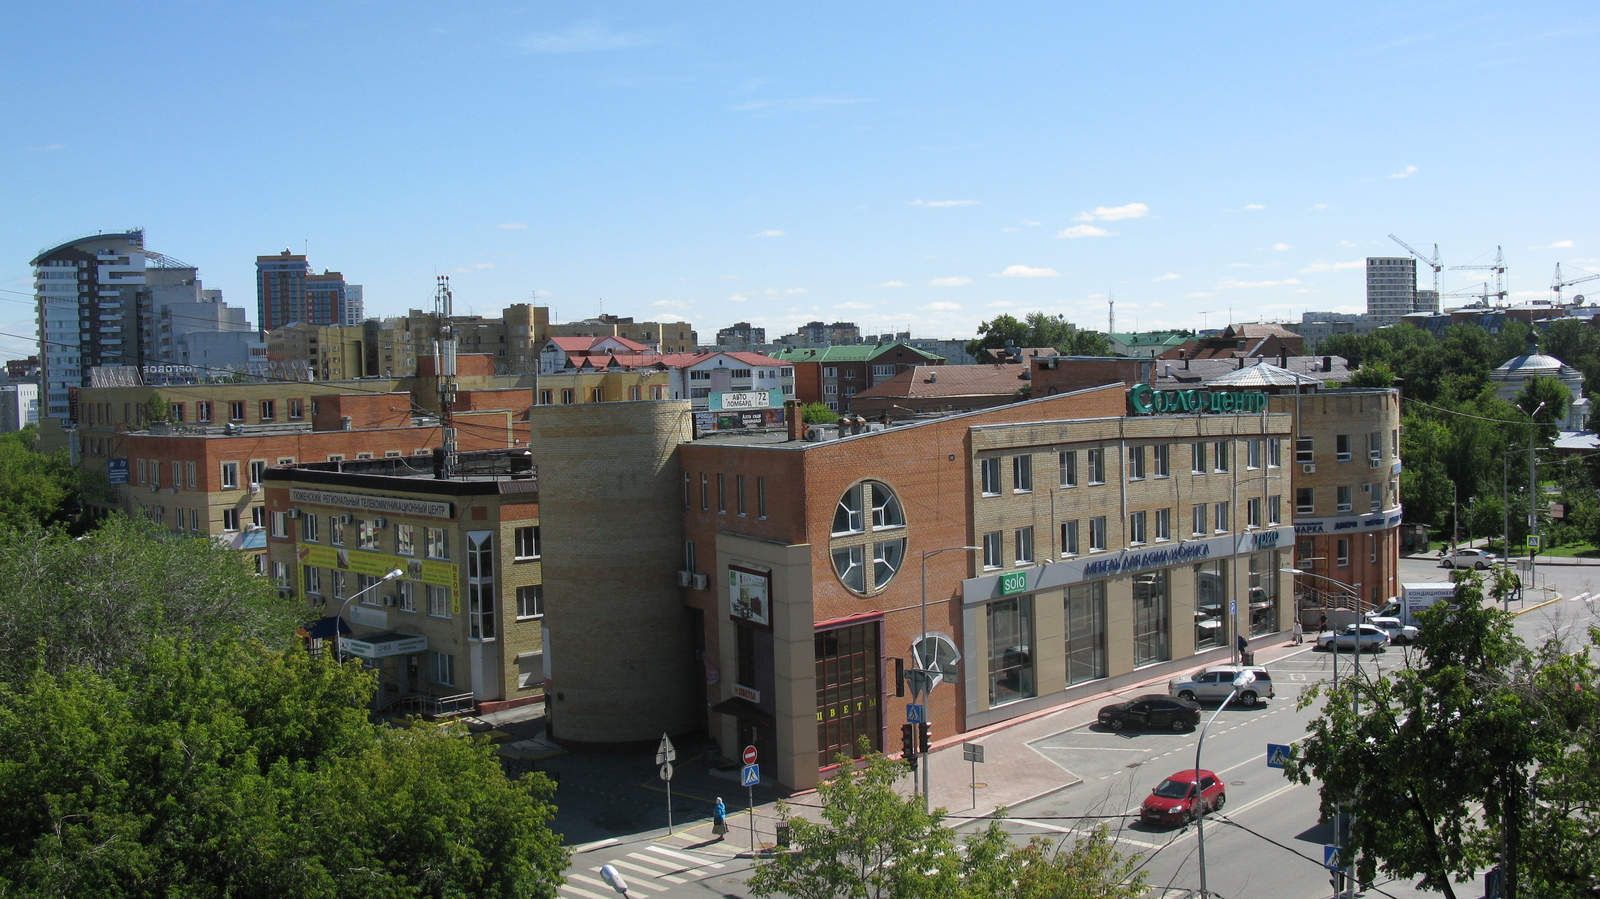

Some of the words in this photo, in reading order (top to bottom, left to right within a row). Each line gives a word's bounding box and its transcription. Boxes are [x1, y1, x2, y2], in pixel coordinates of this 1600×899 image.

[758, 392, 767, 401] 72
[293, 491, 321, 502] ТЮМЕНСКИЙ
[323, 494, 360, 506] РЕГИОНАЛЬНЫЙ
[361, 498, 428, 514] ТЕЛЕКОММУНИКАЦИОННЫЙ
[428, 504, 445, 516] ЦЕНТР
[1085, 557, 1120, 575] МЕБЕЛЬ
[1122, 554, 1141, 569] ДЛЯ
[1141, 549, 1169, 566] ДОМА
[1171, 548, 1177, 560] И
[1178, 543, 1210, 559] ОФИСА
[1004, 573, 1025, 590] solo
[738, 688, 756, 701] ЦВЕТЫ
[816, 697, 877, 721] ЦВЕТЫ
